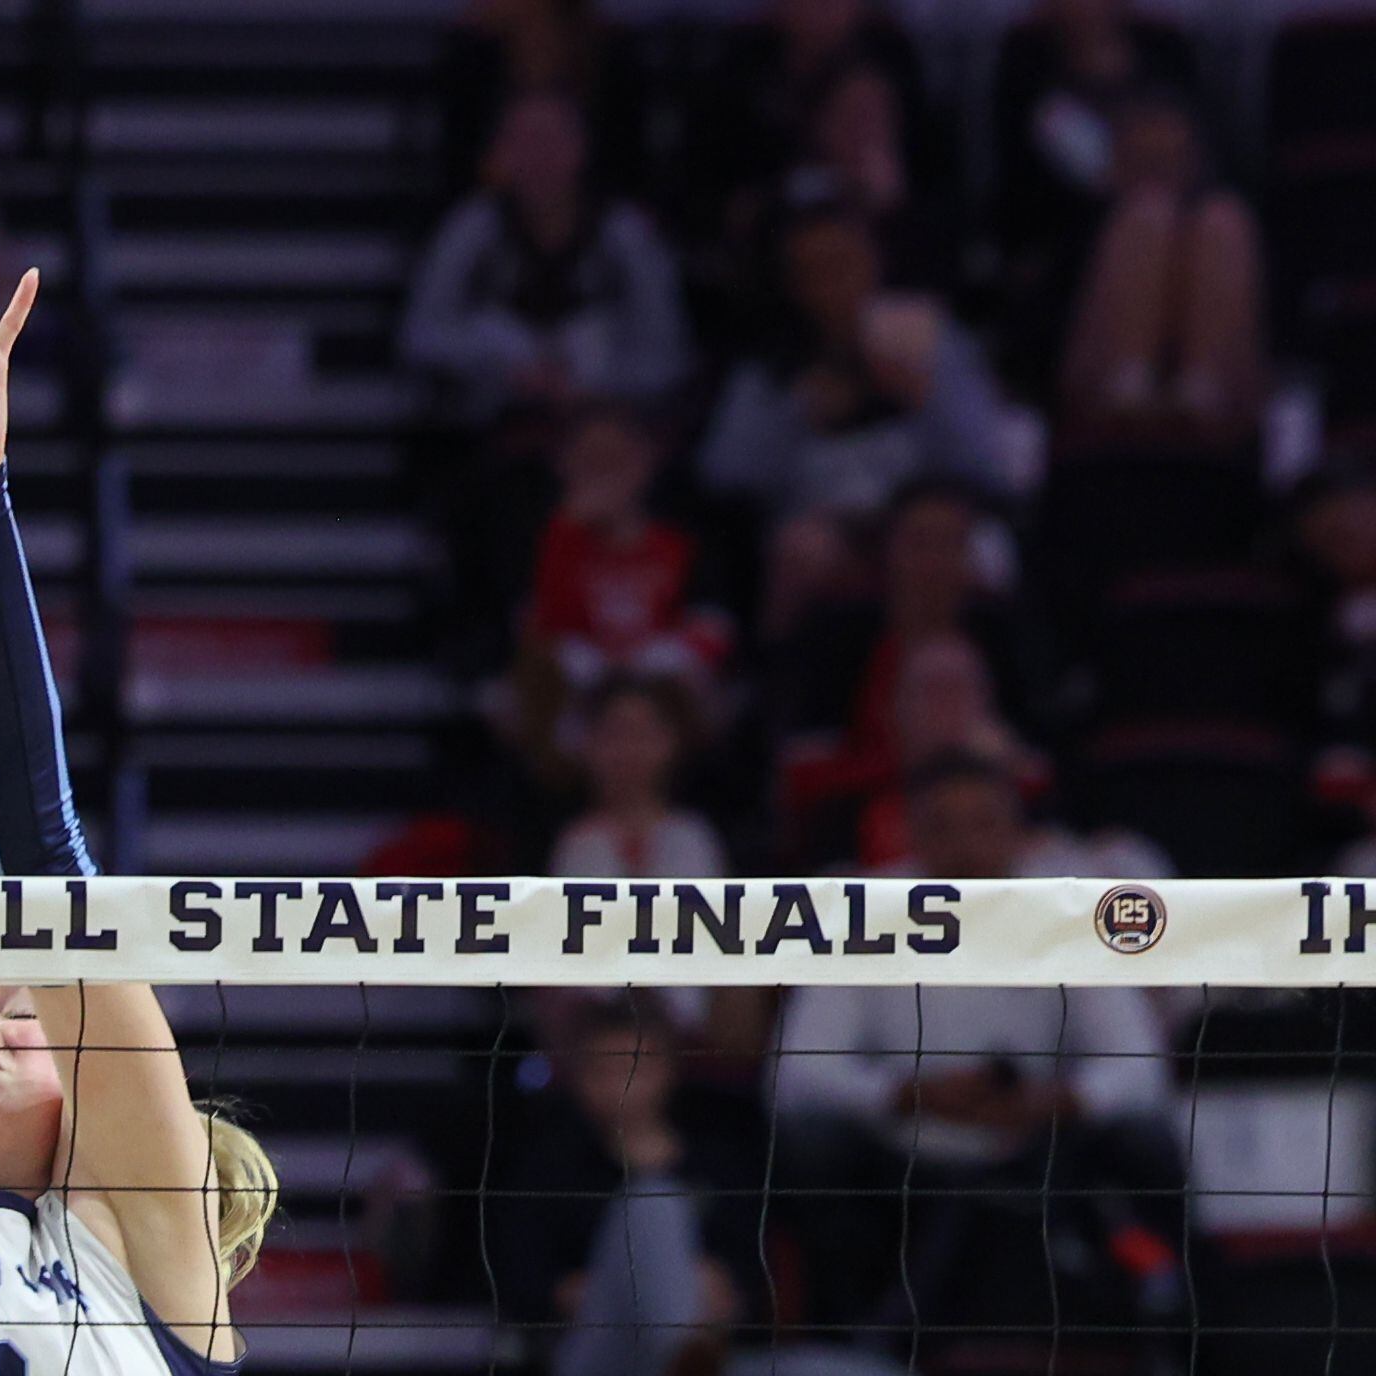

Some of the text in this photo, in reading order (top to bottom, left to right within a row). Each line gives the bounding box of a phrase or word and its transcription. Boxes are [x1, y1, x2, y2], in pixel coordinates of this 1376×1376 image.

[168, 880, 511, 953] STATE
[561, 883, 963, 955] FINALS
[1112, 898, 1149, 924] 125
